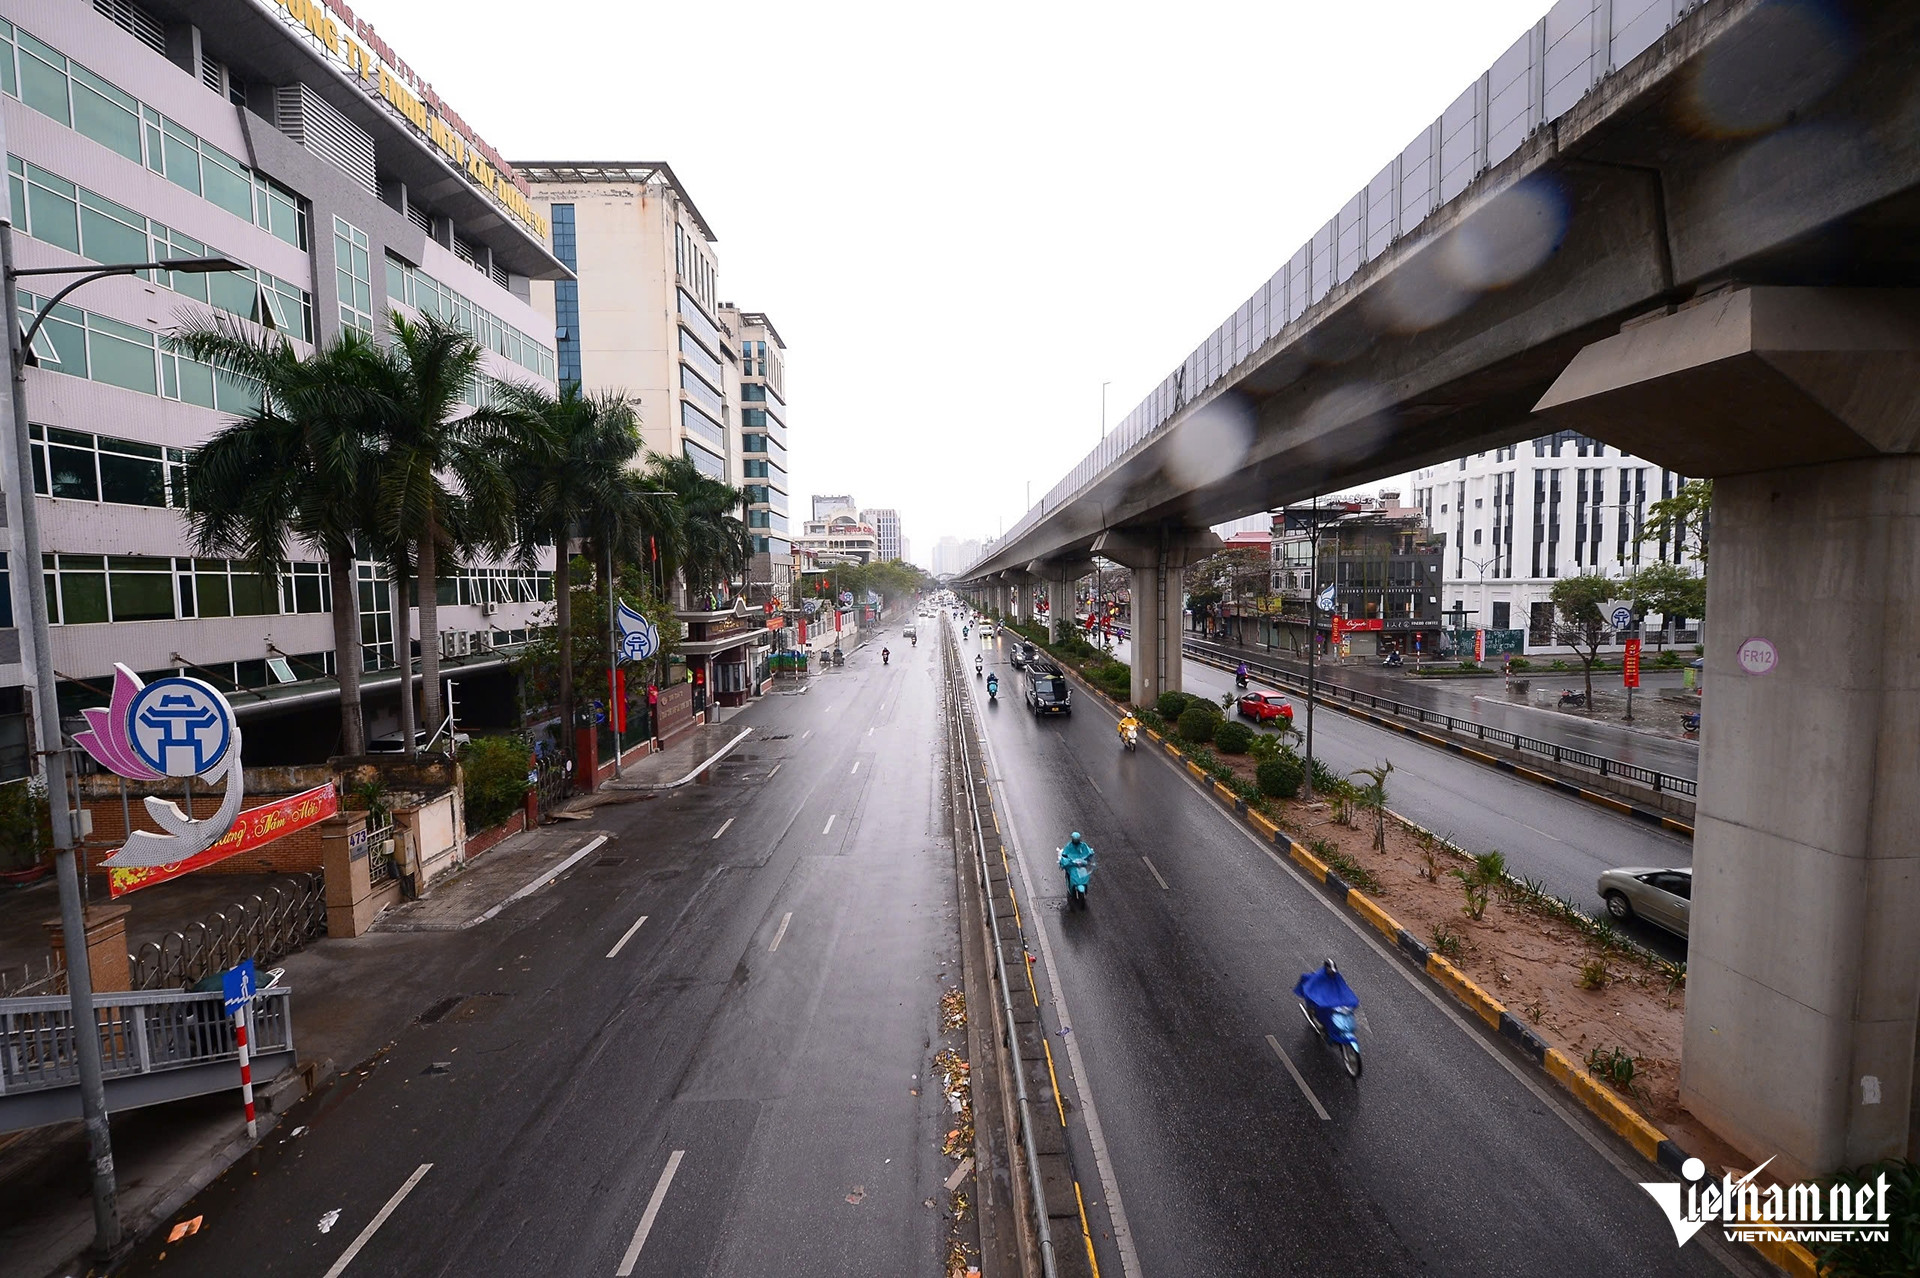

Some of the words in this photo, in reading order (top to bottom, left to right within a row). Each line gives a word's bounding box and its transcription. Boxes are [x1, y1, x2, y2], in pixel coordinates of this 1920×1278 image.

[344, 34, 371, 80] TY
[376, 64, 427, 132] TNHH
[431, 115, 464, 167] MTV
[1743, 650, 1772, 663] FR12
[350, 830, 366, 846] 473
